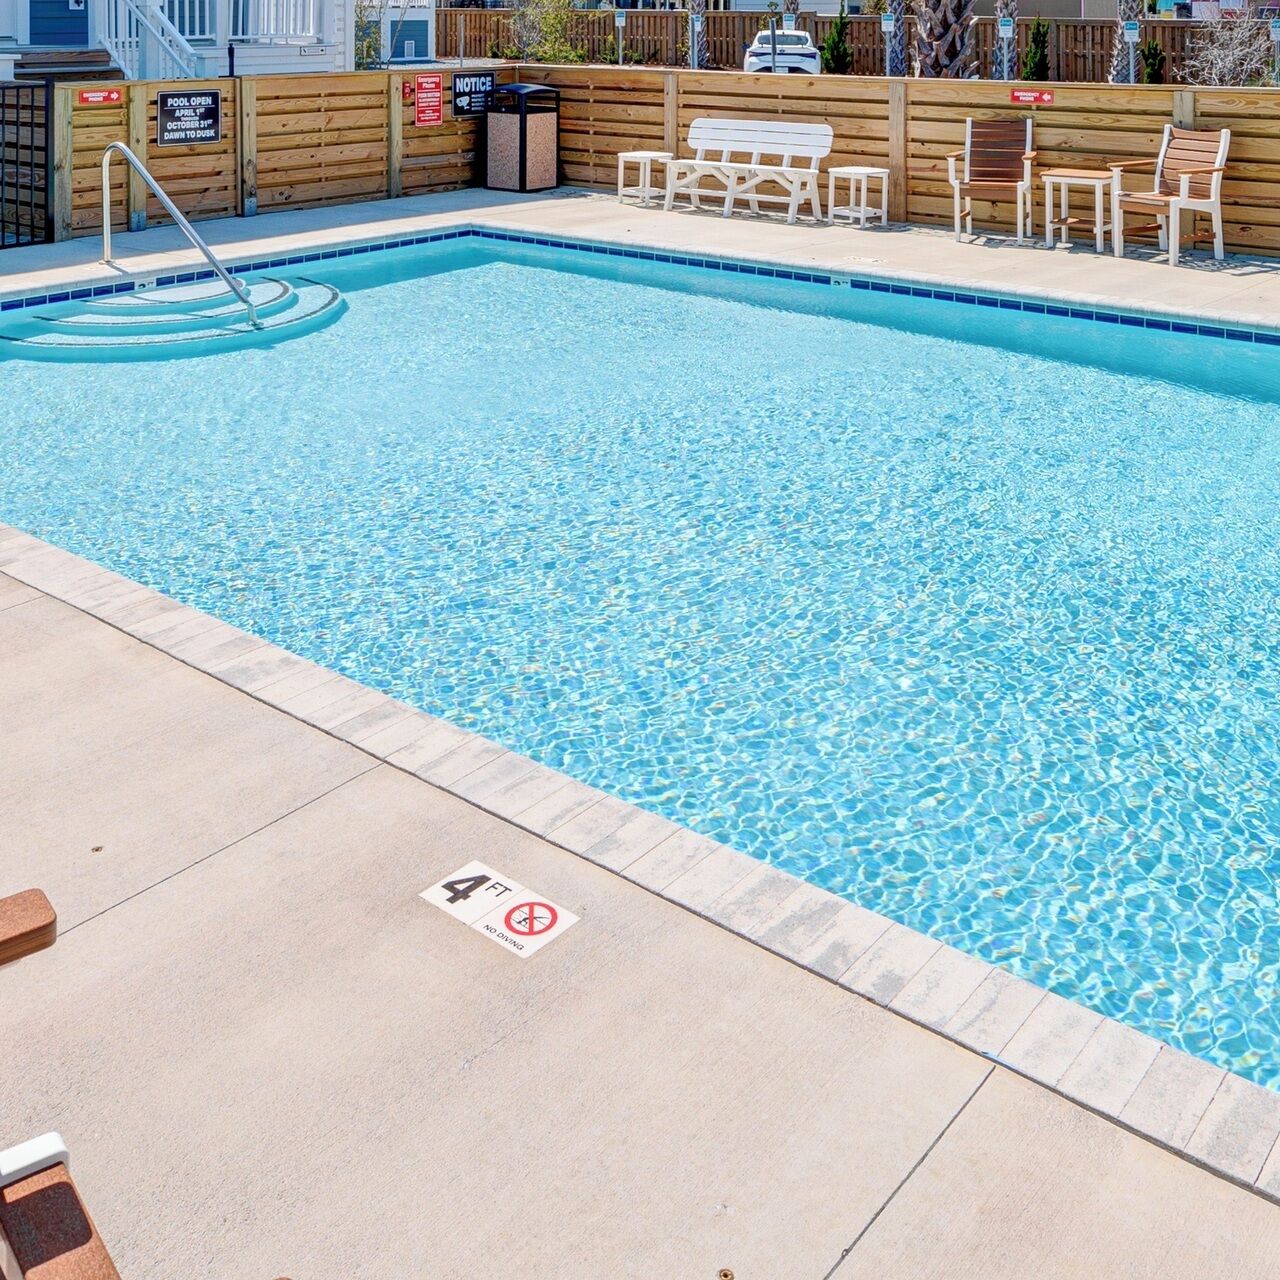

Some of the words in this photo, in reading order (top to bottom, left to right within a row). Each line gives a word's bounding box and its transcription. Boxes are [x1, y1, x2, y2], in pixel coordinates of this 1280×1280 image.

[455, 76, 492, 93] NOTICE
[167, 98, 189, 107] POOL
[190, 96, 212, 106] OPEN
[174, 109, 195, 117] APRIL
[167, 121, 199, 130] OCTOBER
[164, 131, 185, 140] DAWN
[186, 130, 196, 138] TO
[197, 129, 215, 138] DUSK
[441, 874, 492, 904] 4
[485, 881, 512, 897] FT
[483, 924, 497, 934] NO
[496, 932, 524, 951] DIVING
